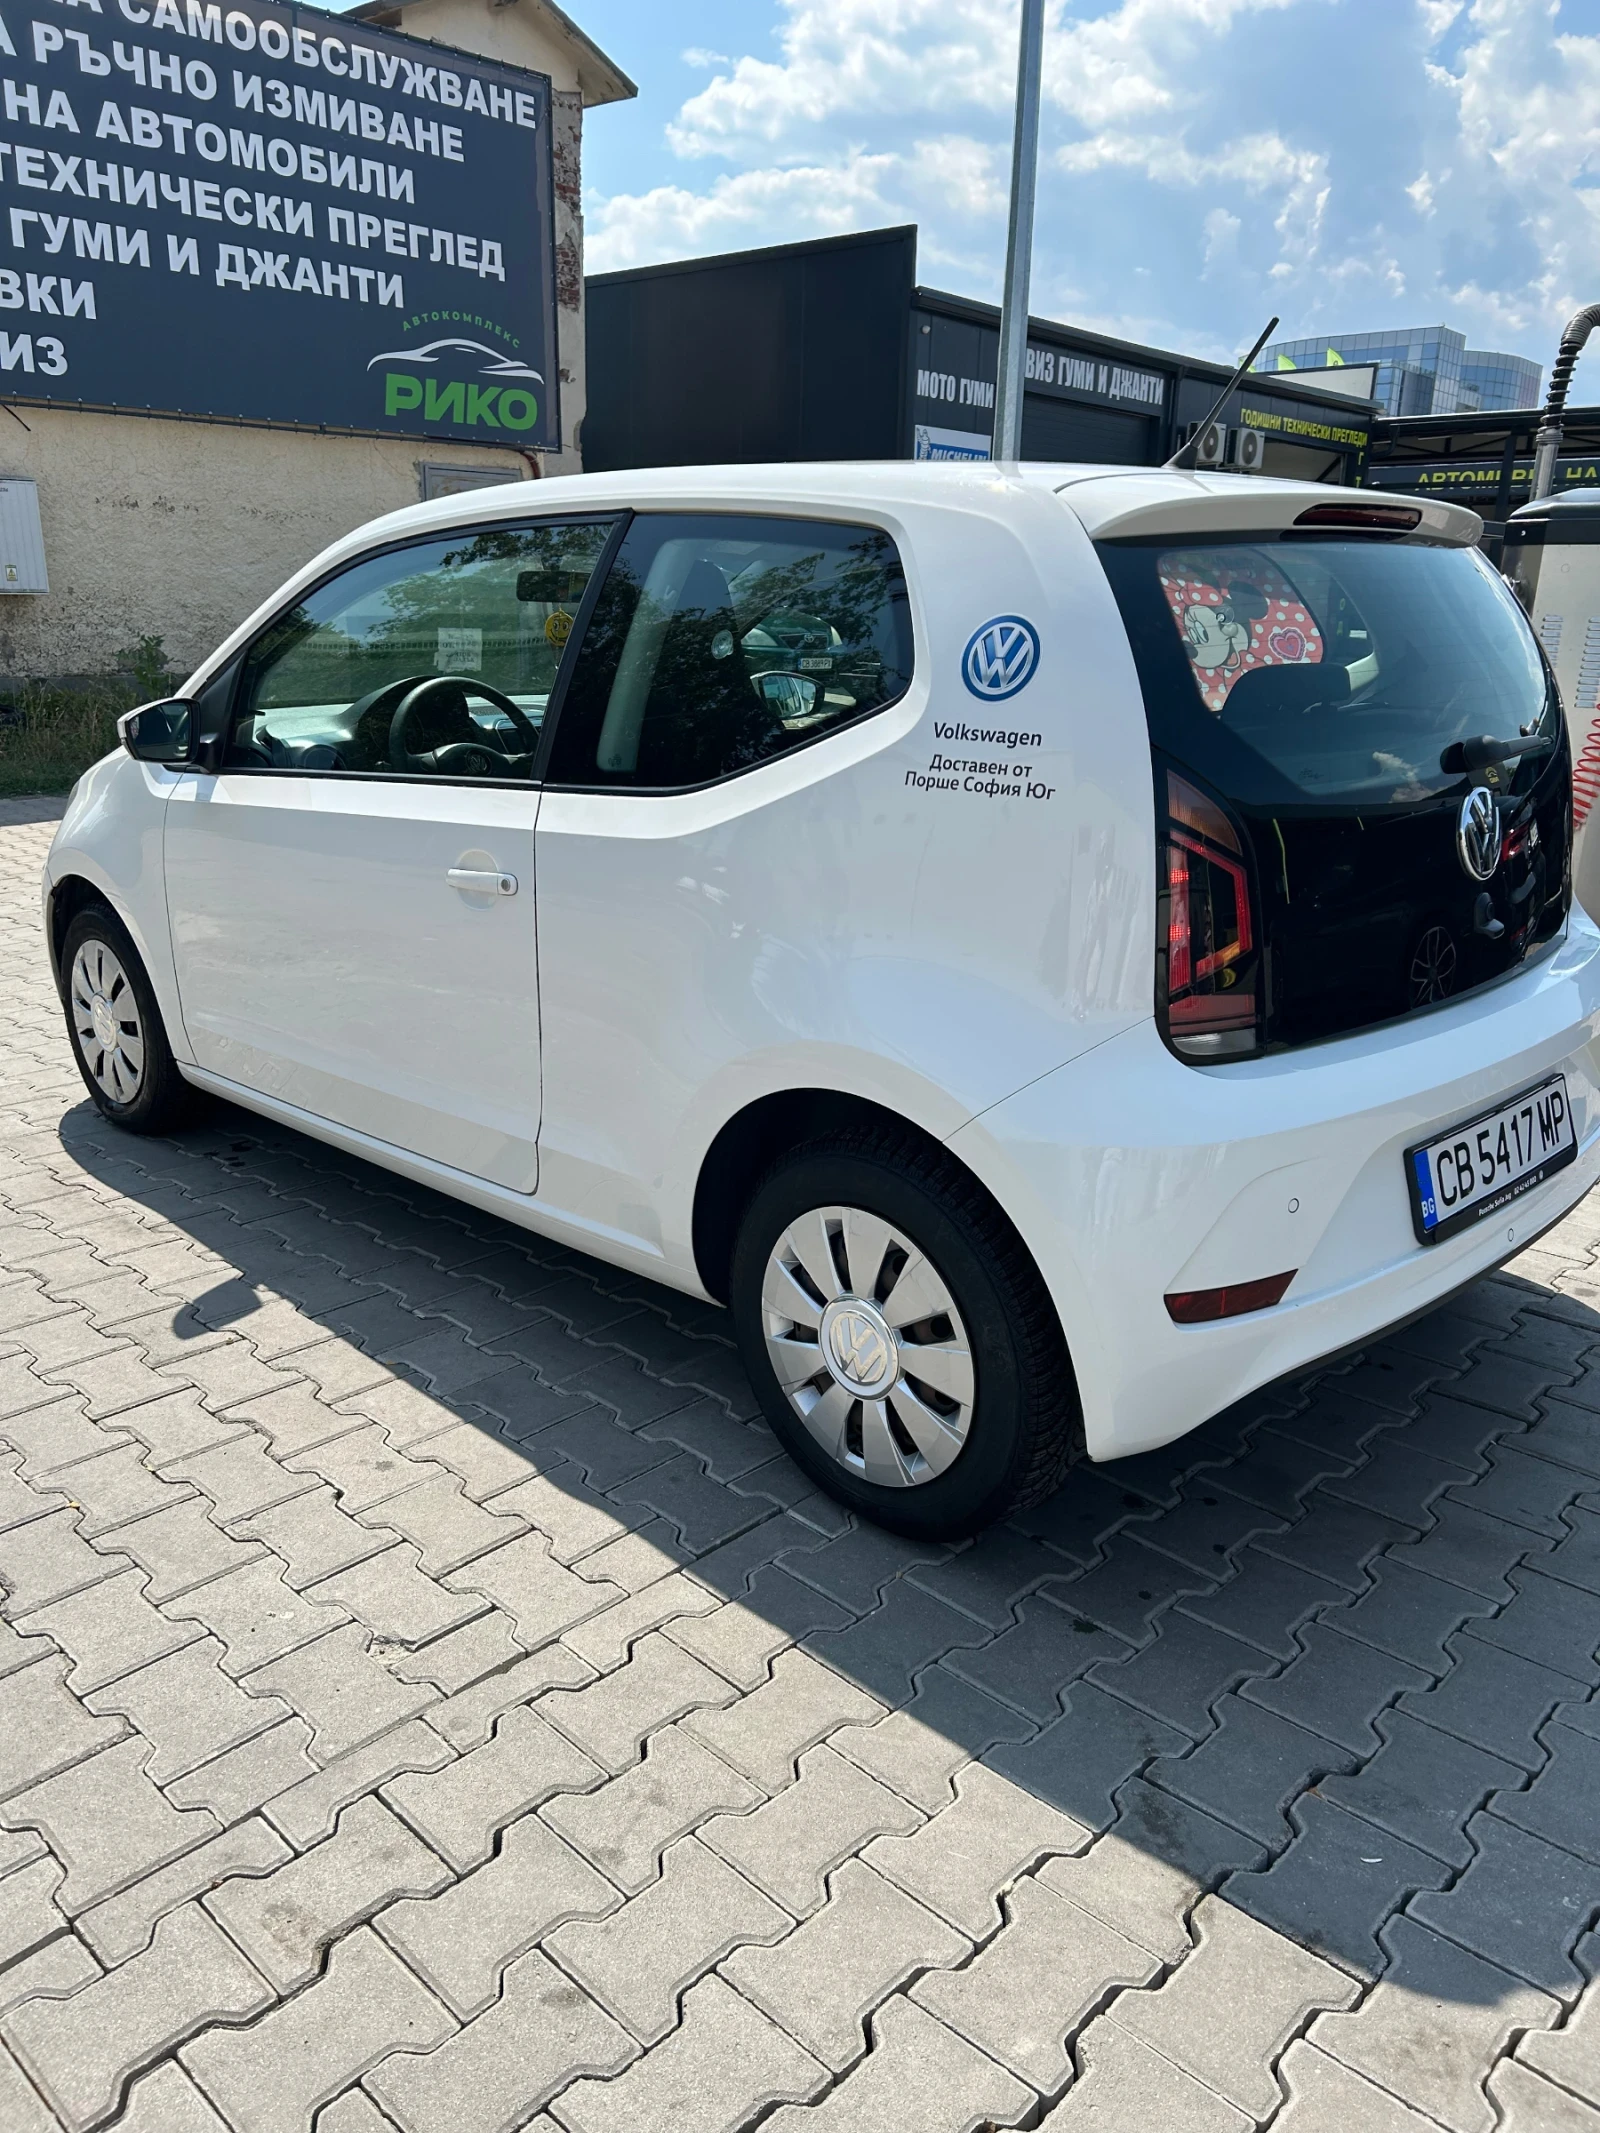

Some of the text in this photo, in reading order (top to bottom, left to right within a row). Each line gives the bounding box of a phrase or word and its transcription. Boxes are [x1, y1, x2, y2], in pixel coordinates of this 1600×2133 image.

[118, 0, 537, 129] САМООБСЛУЖВАНЕ
[32, 20, 218, 101] РЪЧНО
[232, 70, 465, 163] ИЗМИВАНЕ
[3, 78, 415, 204] НА АВТОМОБИЛИ
[9, 207, 404, 309] ГУМИ И ДЖАНТИ
[328, 206, 506, 282] ПРЕГЛЕД
[403, 310, 520, 348] АВТОКОМПЛЕКС
[385, 373, 538, 430] РИКО
[917, 369, 994, 408] МОТО ГУМИ
[1057, 356, 1095, 392] ГУМИ
[1098, 365, 1107, 394] И
[1109, 368, 1164, 406] ДЖАНТИ
[1240, 408, 1368, 447] ГОДИШНИ ТЕХНИЧЕСКИ ПРЕГЛЕДИ
[934, 722, 1042, 748] Volkswagen
[905, 771, 1056, 800] Порше София Юг
[929, 754, 1032, 777] Доставен от
[1421, 1197, 1436, 1219] BG
